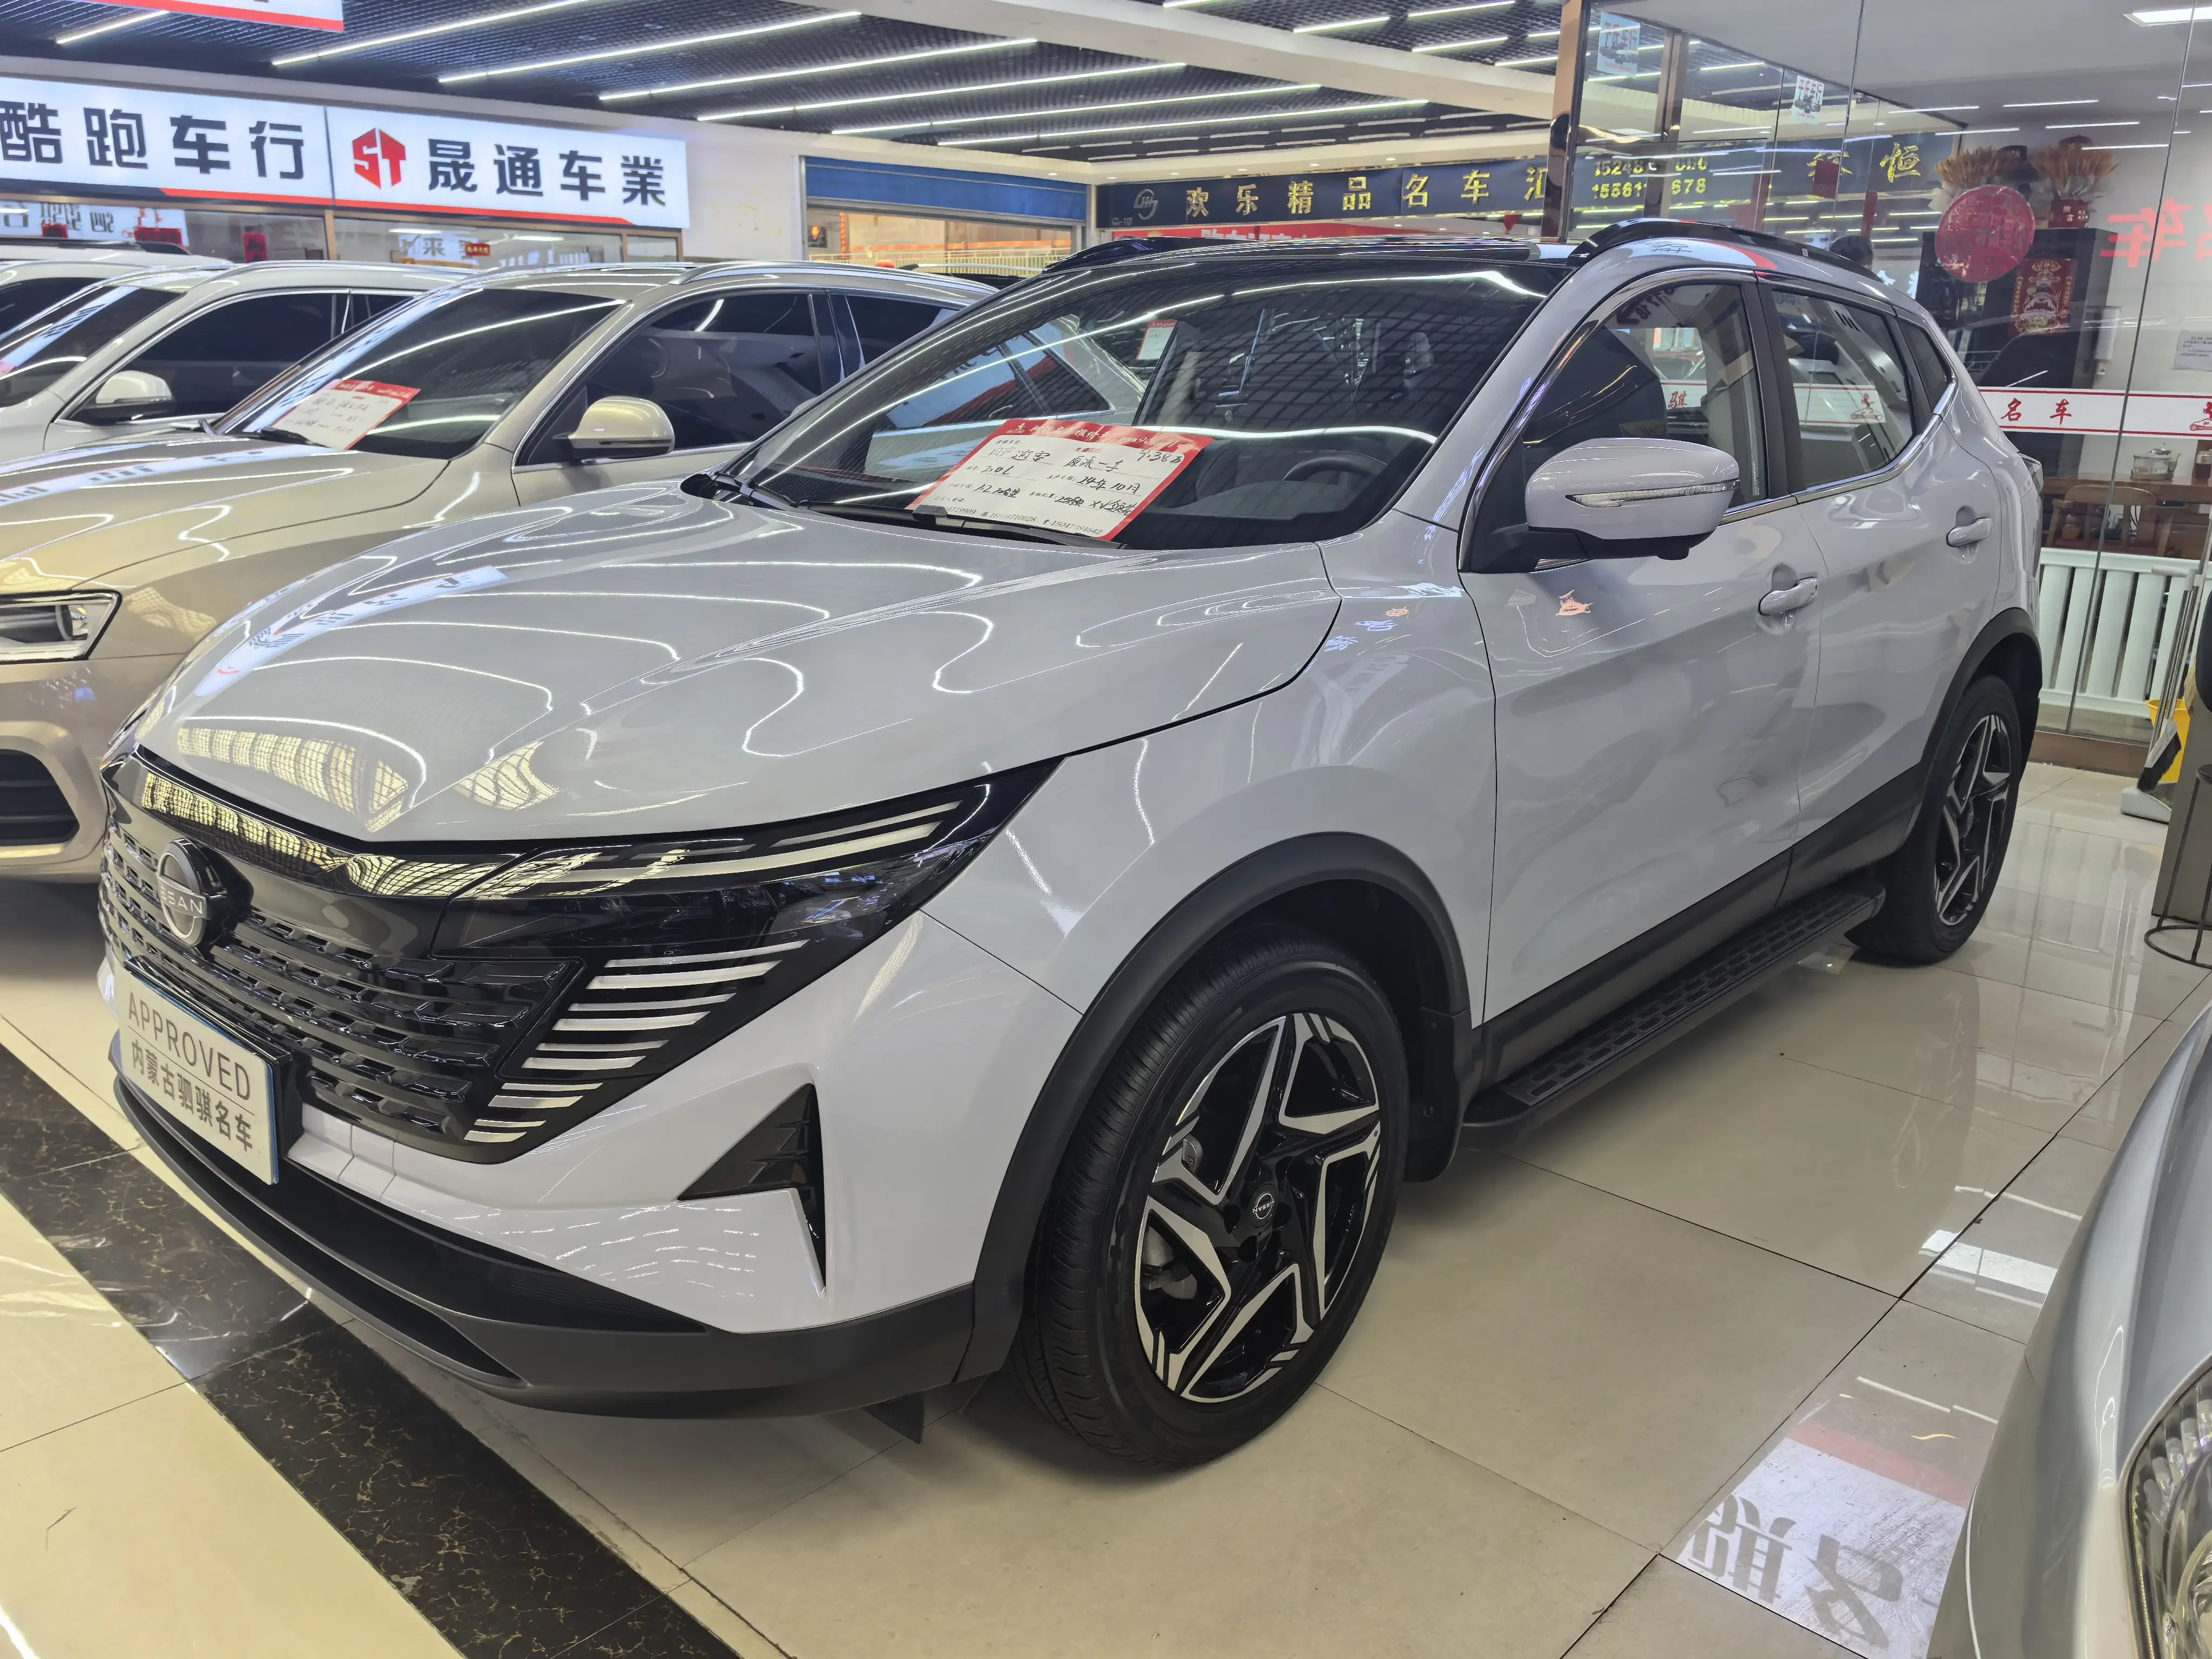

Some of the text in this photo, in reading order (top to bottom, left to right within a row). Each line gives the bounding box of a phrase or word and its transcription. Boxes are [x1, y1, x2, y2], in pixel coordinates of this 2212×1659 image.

[0, 100, 304, 180] 酷跑车行
[428, 138, 666, 207] 晟通车業
[1186, 166, 1547, 218] 欢乐精品名车汇
[2001, 397, 2072, 426] 名车
[129, 991, 251, 1101] APPROVED
[132, 1038, 253, 1152] 内蒙古驷骐名车
